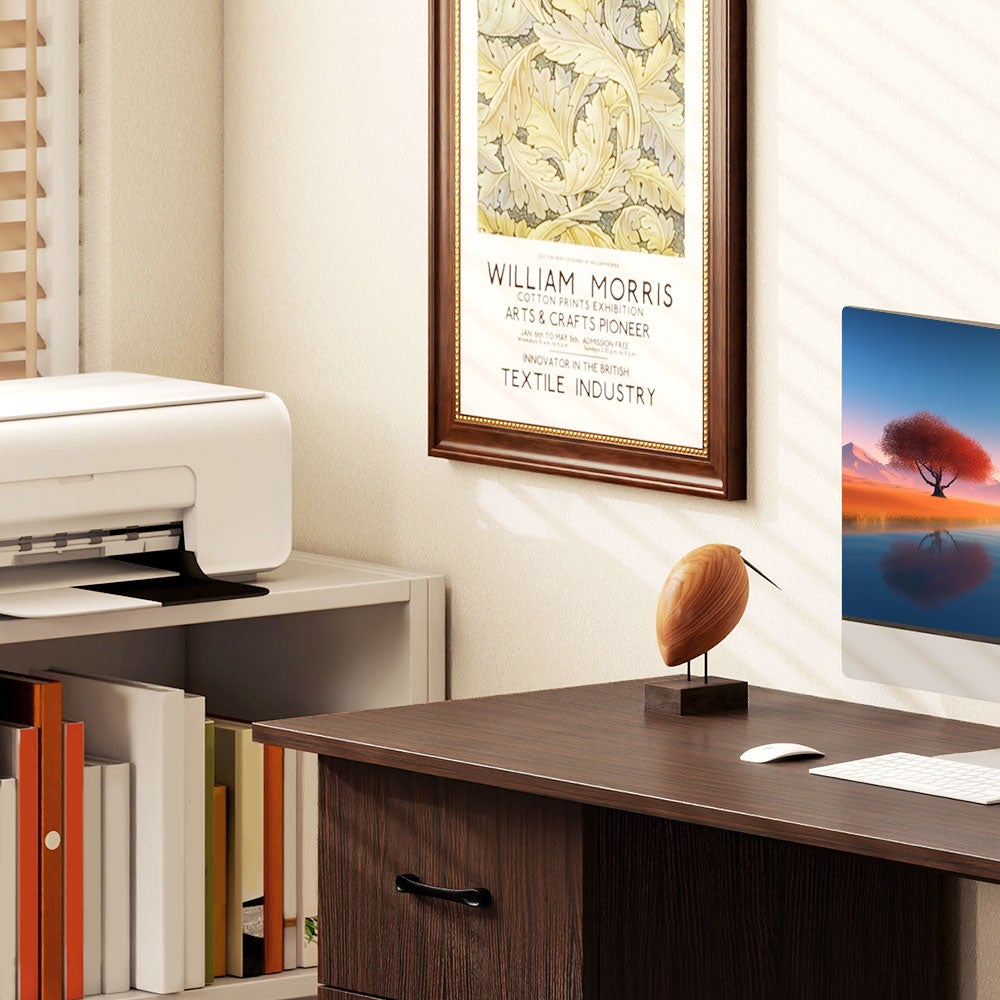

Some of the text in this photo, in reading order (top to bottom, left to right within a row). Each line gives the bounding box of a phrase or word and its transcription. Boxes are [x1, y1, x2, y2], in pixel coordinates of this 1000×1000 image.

[487, 261, 673, 308] WILLIAM MORRIS
[517, 291, 644, 316] COTTON PRINTS EXHIBITION
[505, 306, 649, 339] ARTS & CRAFTS PIONEER
[523, 353, 629, 377] INNOVATOR IN THE BRITISH
[501, 367, 656, 406] TEXTILE INDUSTRY
